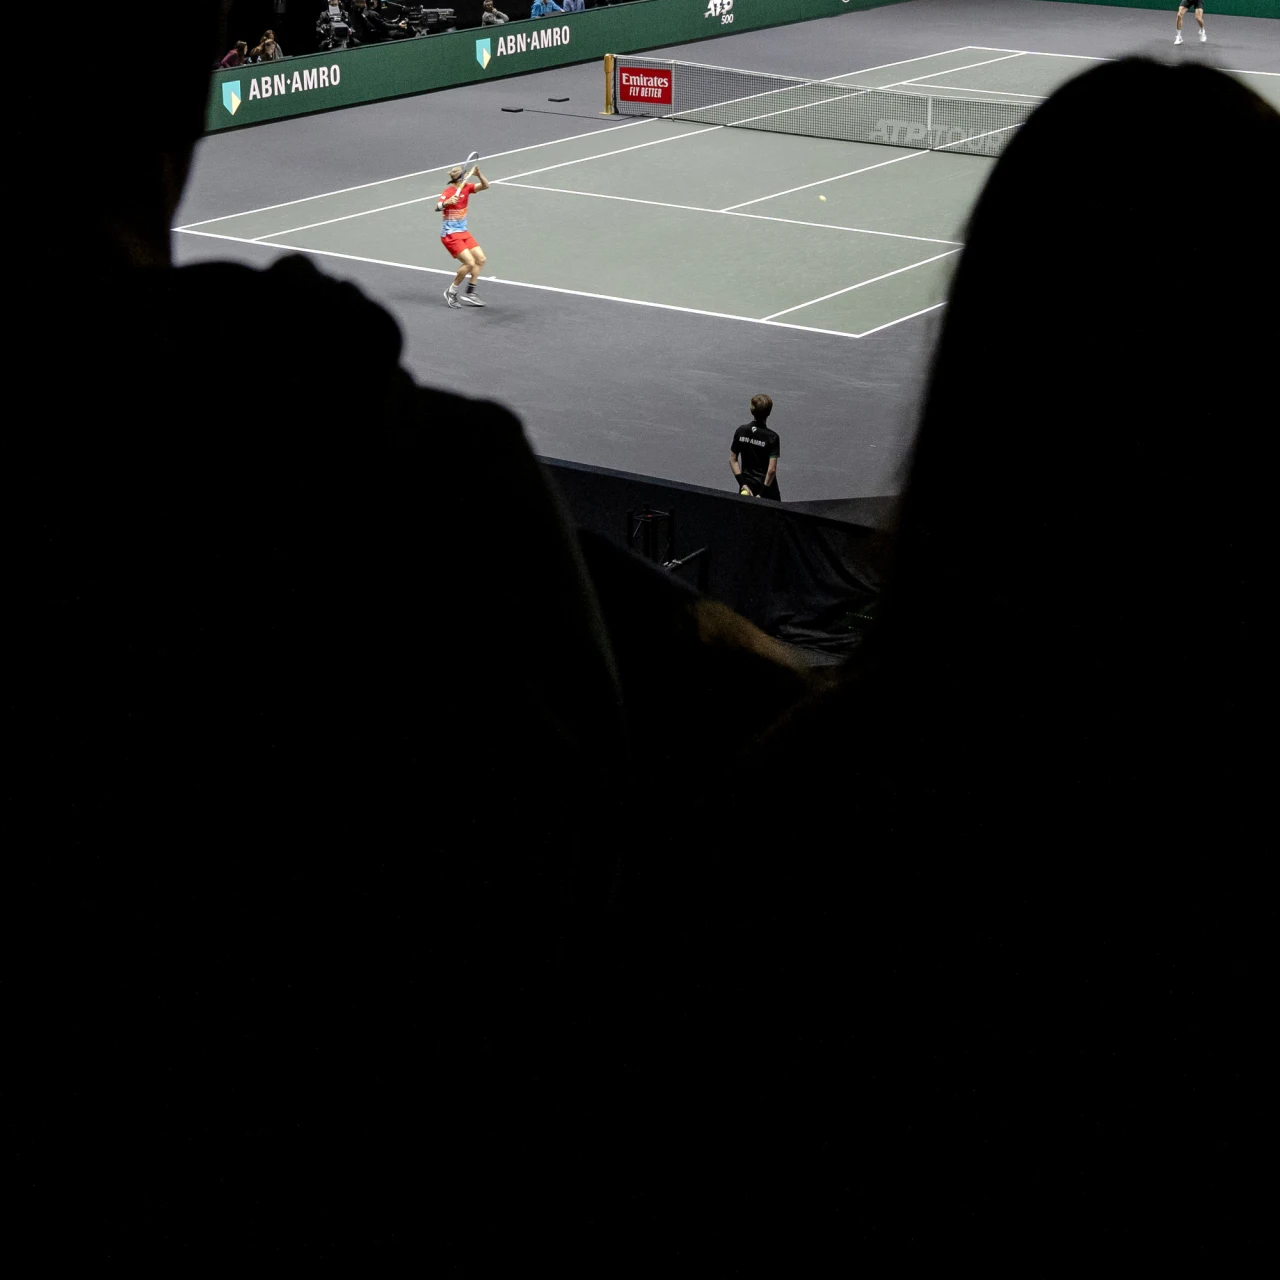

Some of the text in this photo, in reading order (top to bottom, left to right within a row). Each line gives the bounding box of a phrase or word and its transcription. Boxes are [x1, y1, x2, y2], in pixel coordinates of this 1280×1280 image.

[721, 14, 734, 24] 500
[622, 73, 669, 87] Emirates
[629, 87, 662, 98] FLY BETTER
